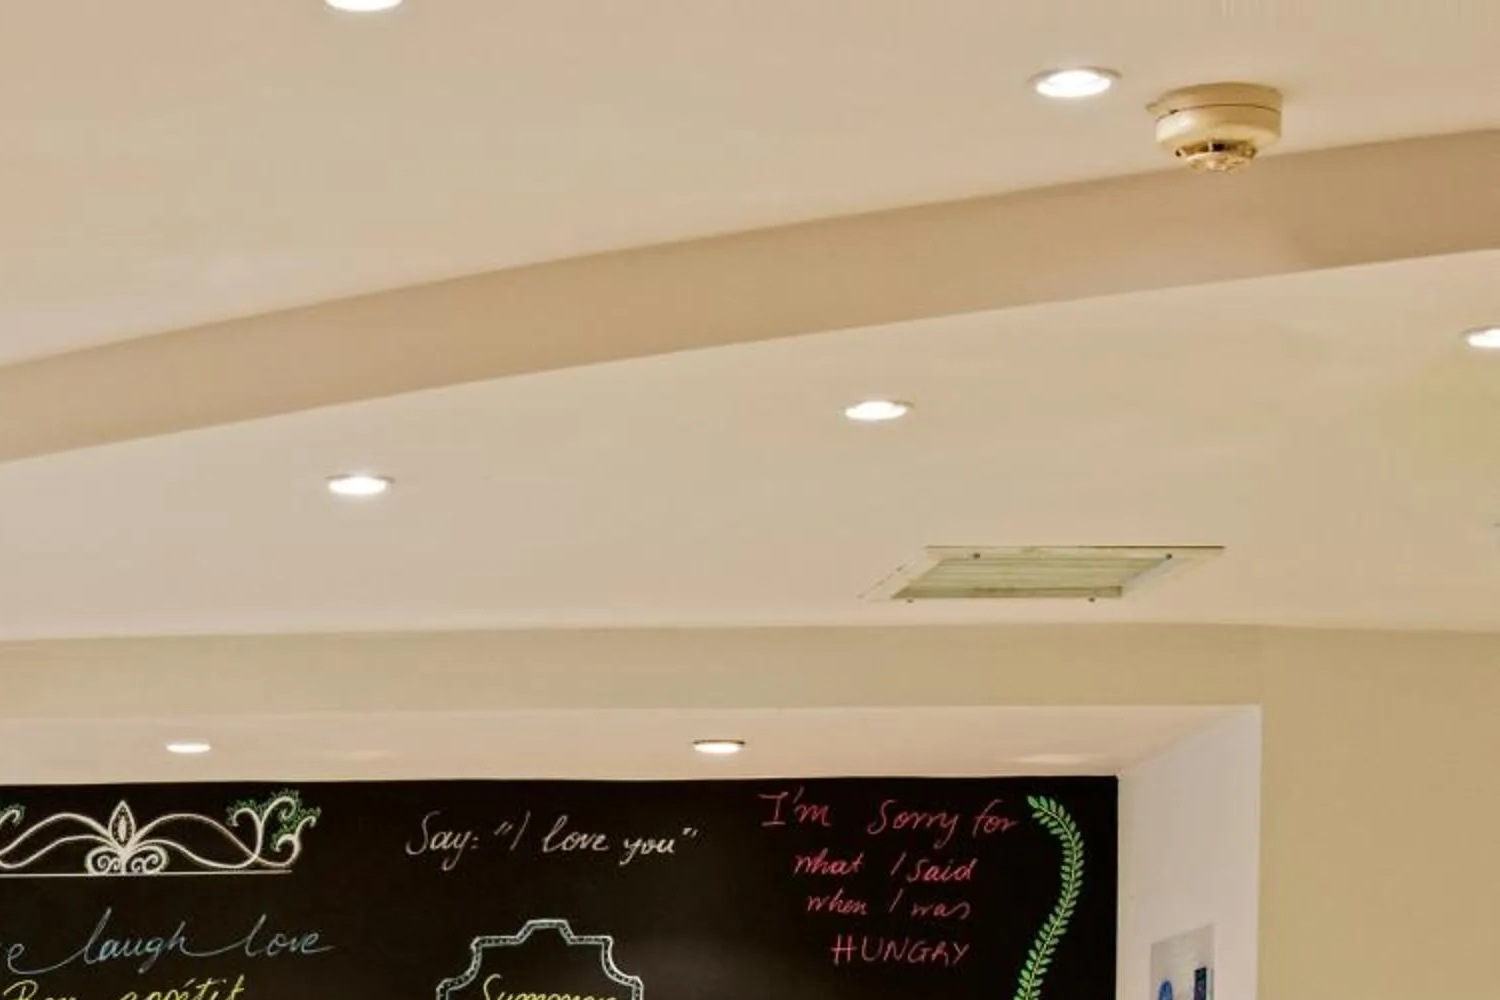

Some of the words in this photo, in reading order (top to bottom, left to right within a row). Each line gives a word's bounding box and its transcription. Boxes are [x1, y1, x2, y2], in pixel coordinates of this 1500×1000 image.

[759, 787, 831, 827] I'm
[973, 799, 1018, 837] for
[542, 816, 608, 852] love
[793, 848, 865, 876] what
[807, 888, 867, 915] when
[911, 901, 971, 919] was
[64, 909, 192, 974] laugh
[224, 914, 332, 956] love
